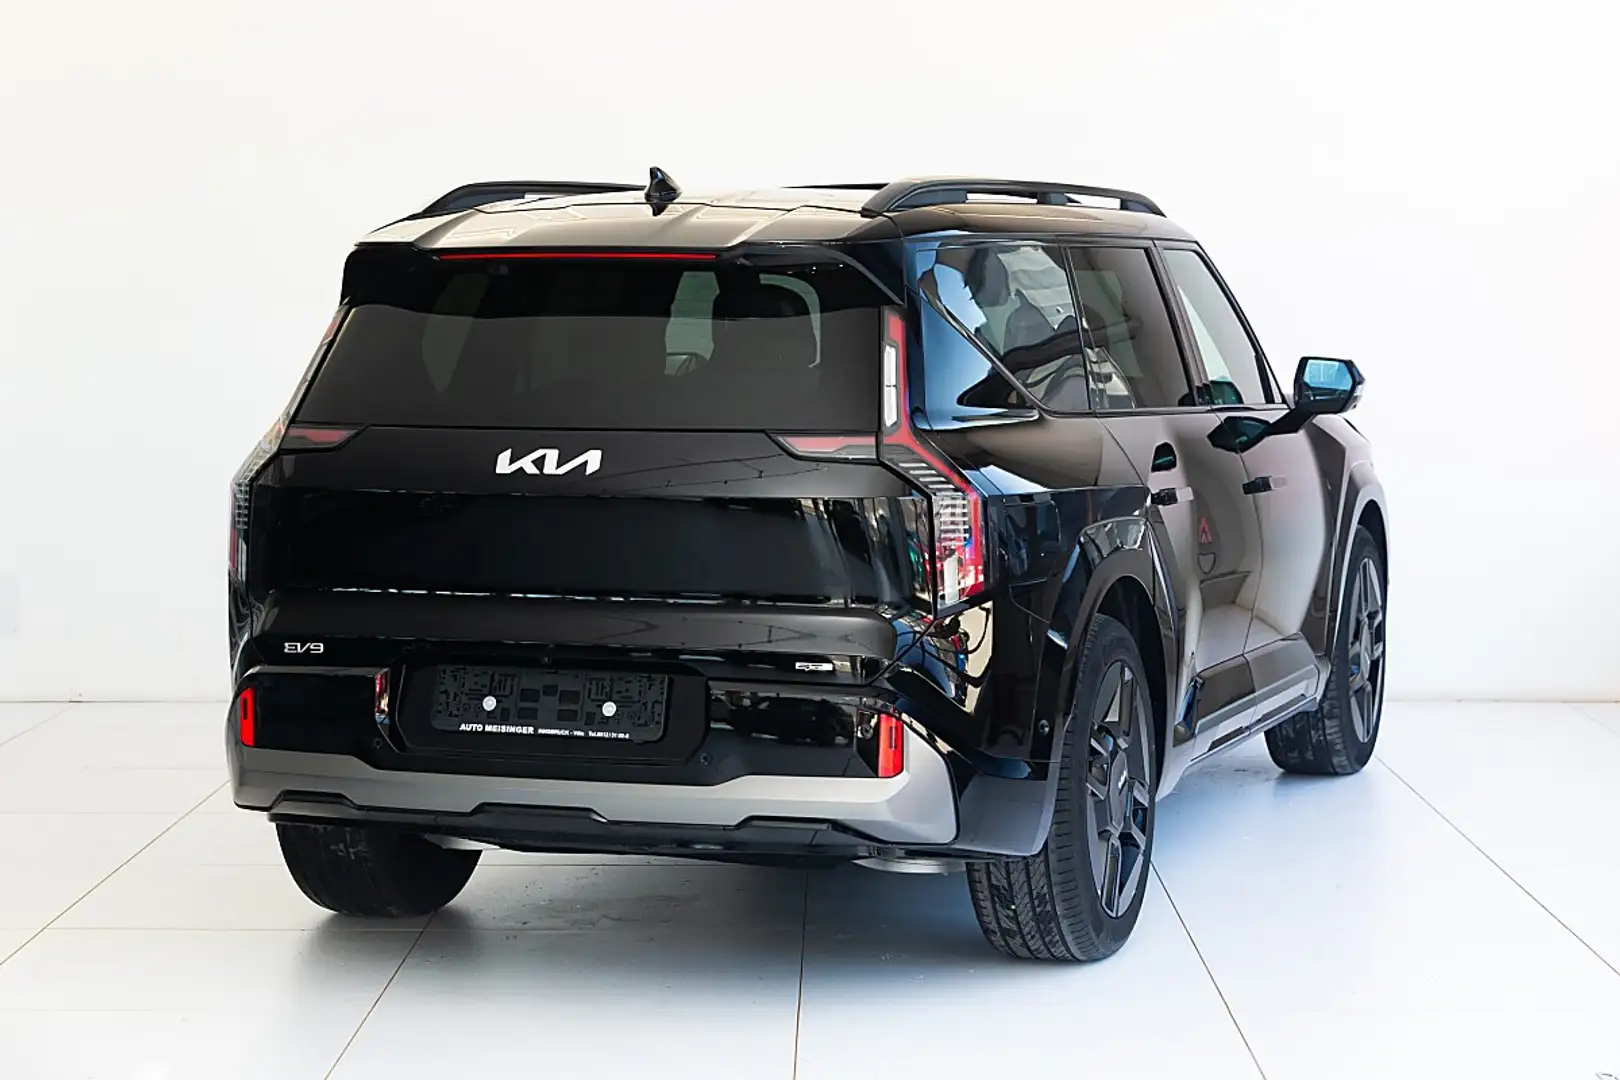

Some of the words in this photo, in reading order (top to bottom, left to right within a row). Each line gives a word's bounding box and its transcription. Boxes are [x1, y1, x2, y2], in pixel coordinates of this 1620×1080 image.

[495, 448, 602, 476] KIA
[283, 642, 324, 653] EV9
[459, 723, 484, 732] AUTO
[484, 724, 535, 734] MEISINGER
